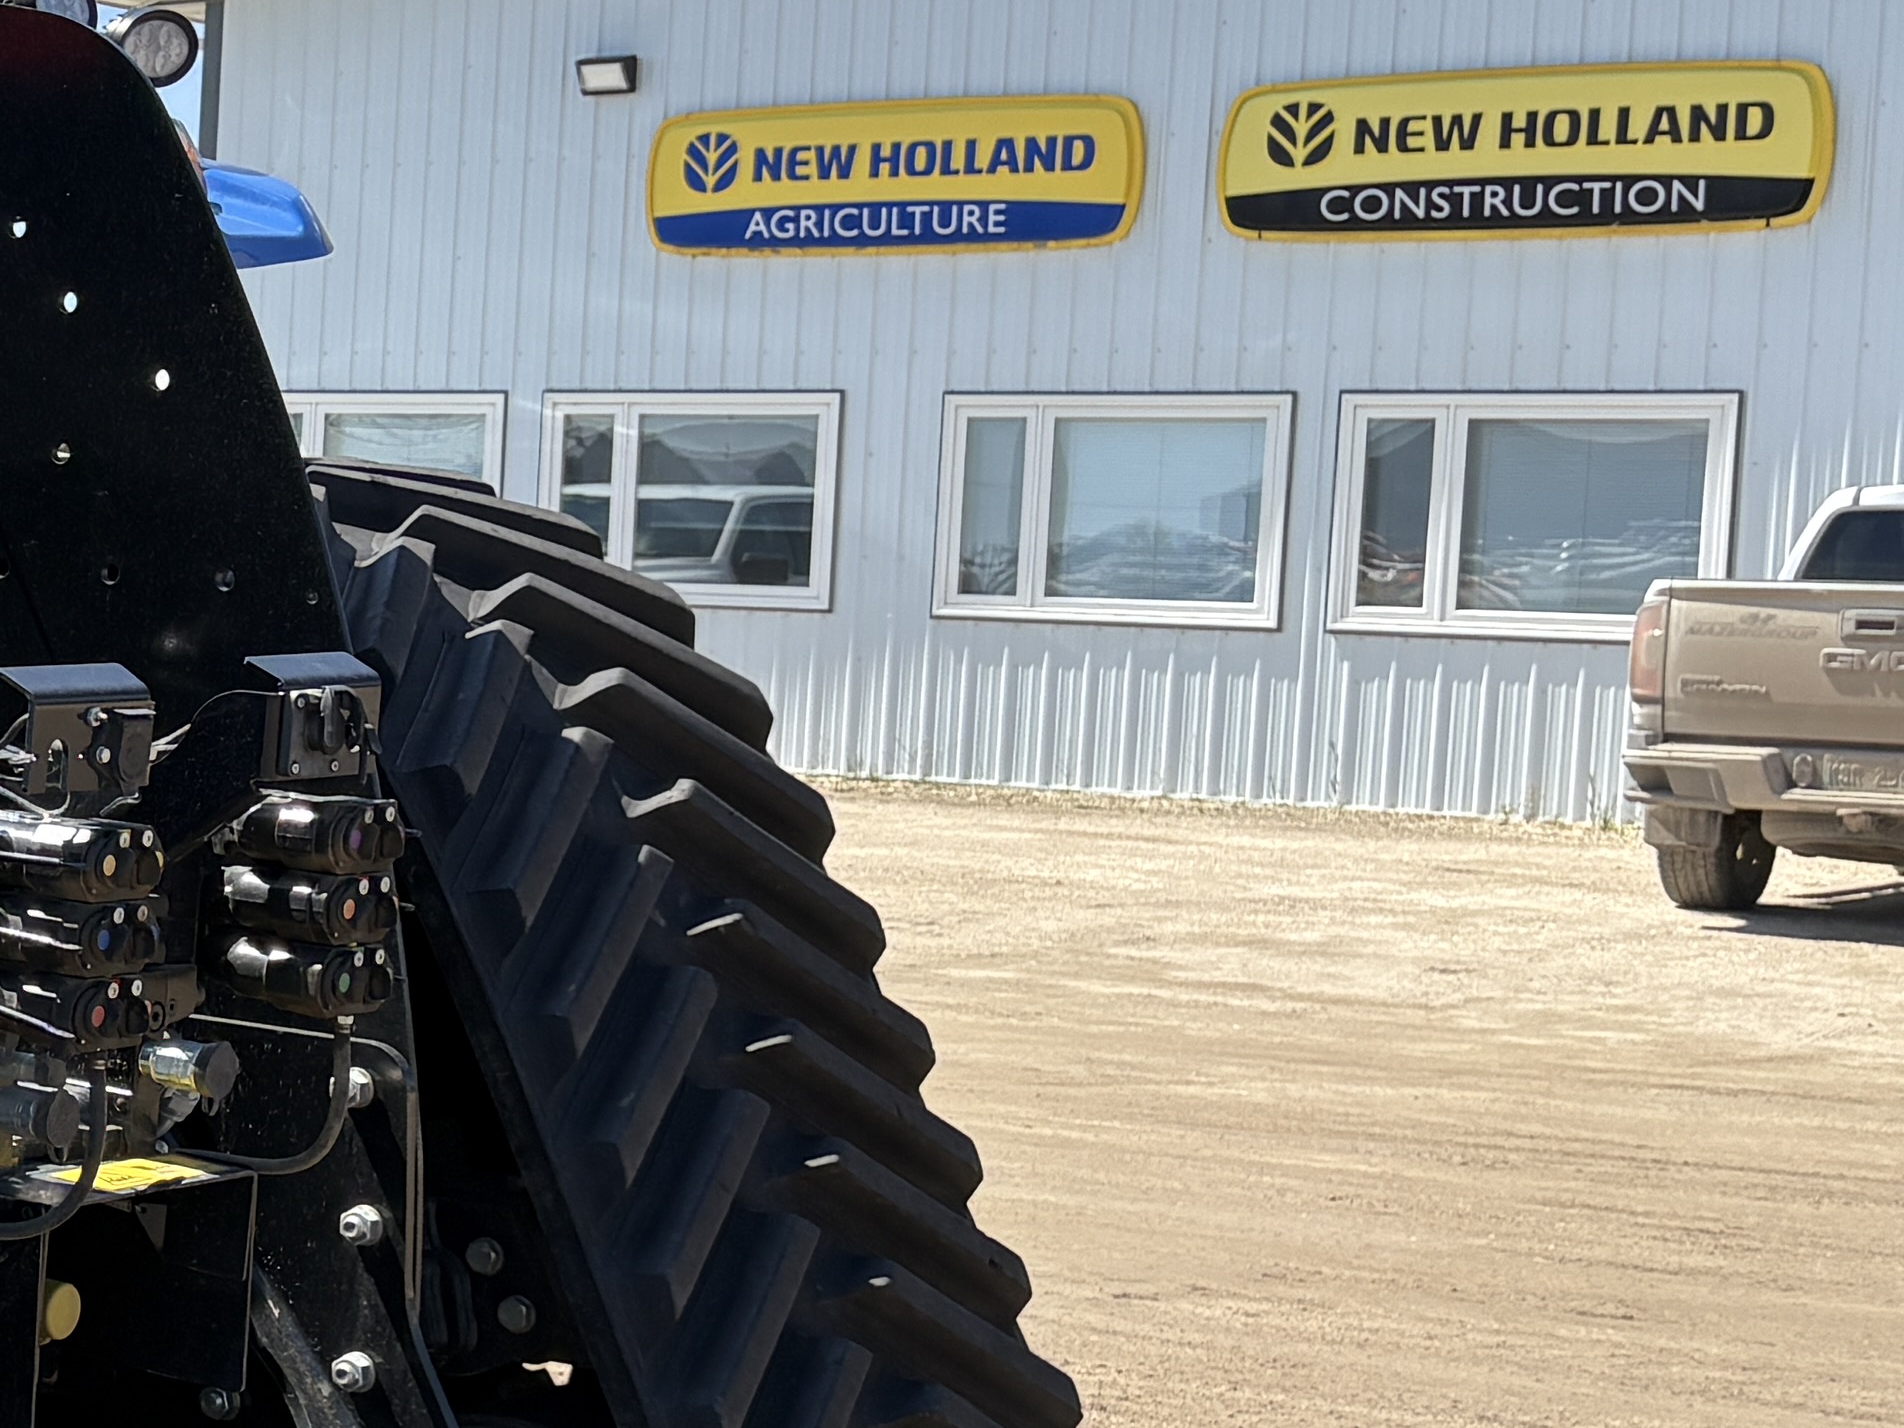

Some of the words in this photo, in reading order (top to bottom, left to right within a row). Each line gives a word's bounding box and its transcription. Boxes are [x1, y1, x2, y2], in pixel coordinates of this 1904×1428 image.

[1353, 112, 1483, 155] NEW
[1498, 101, 1775, 150] HOLLAND
[752, 144, 858, 182] NEW
[869, 134, 1096, 179] HOLLAND
[744, 204, 1006, 239] AGRICULTURE
[1319, 179, 1706, 222] CONSTRUCTION
